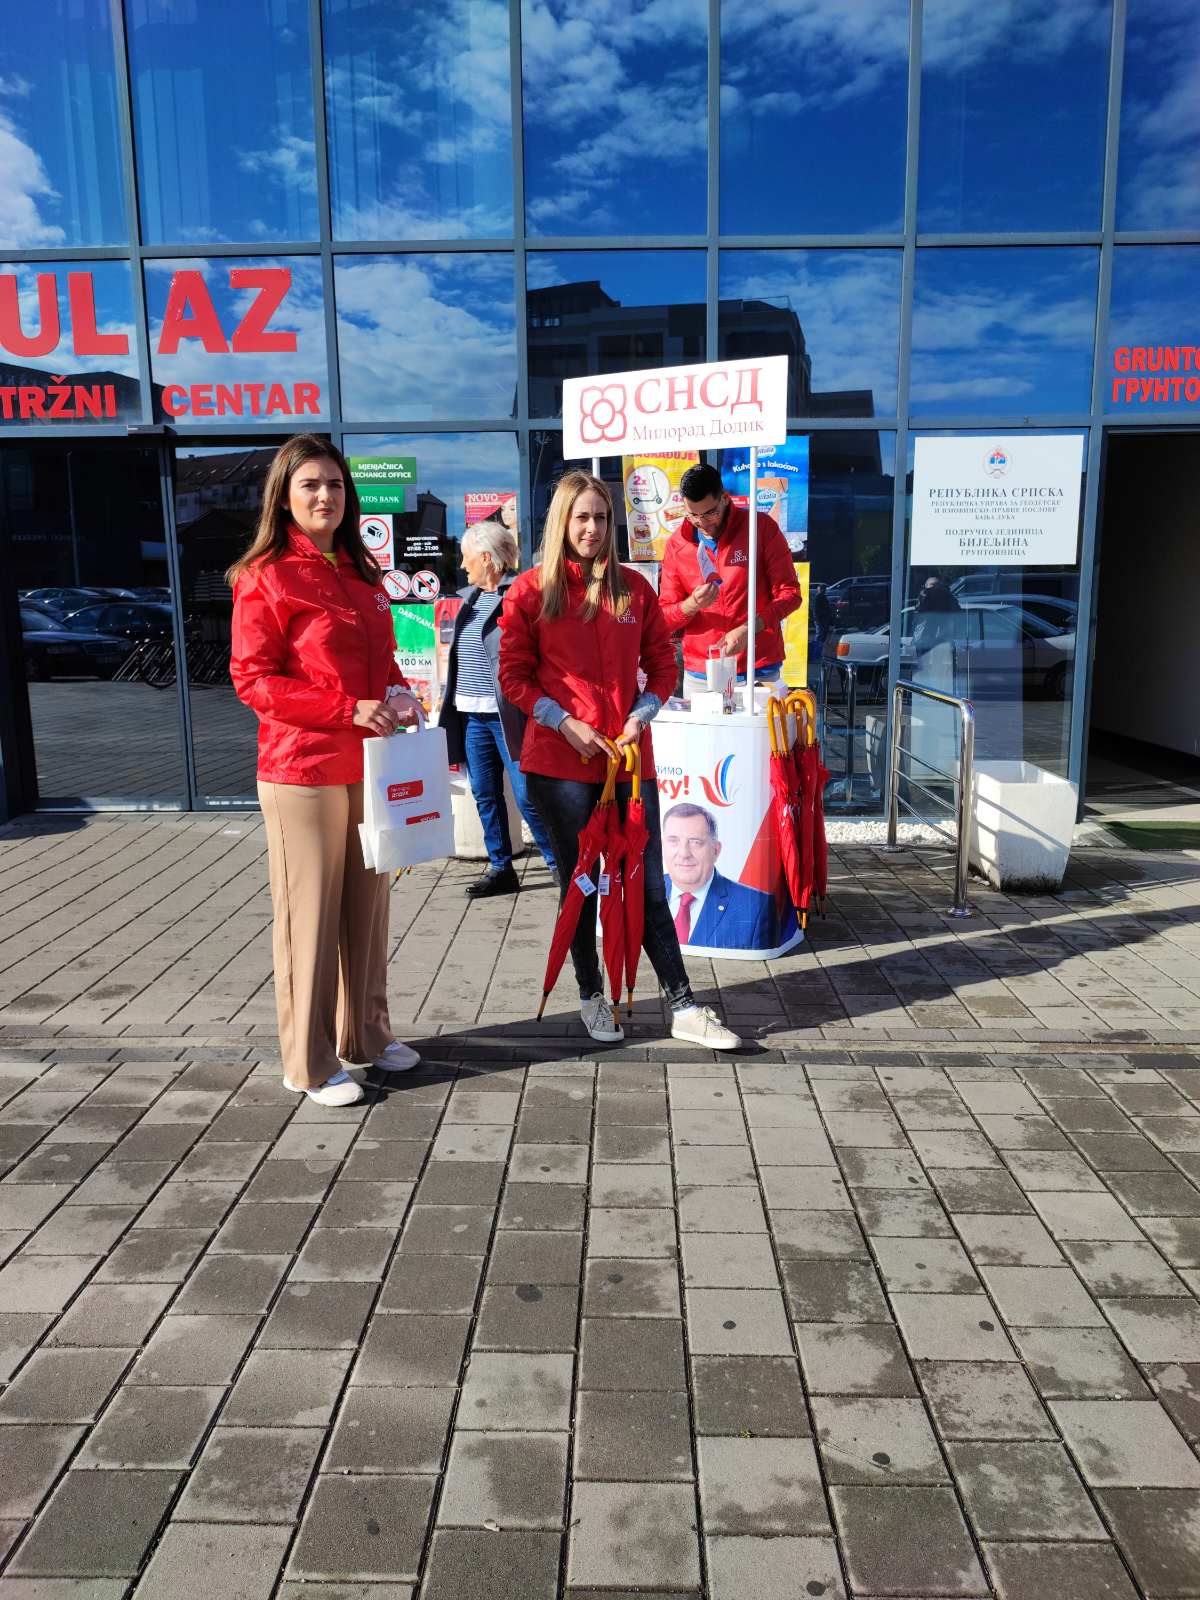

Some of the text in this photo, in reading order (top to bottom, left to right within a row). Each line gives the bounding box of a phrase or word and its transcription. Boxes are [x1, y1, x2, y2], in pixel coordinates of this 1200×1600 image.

[0, 375, 320, 419] TRŽNI CENTAR
[634, 368, 763, 415] СНСД
[632, 420, 764, 442] Милорад Додик
[468, 494, 498, 502] NOVO
[929, 487, 1064, 498] РЕПУБЛИКА СРПСКА
[959, 537, 1029, 547] БИЈЕЉИНА
[400, 658, 416, 666] 100
